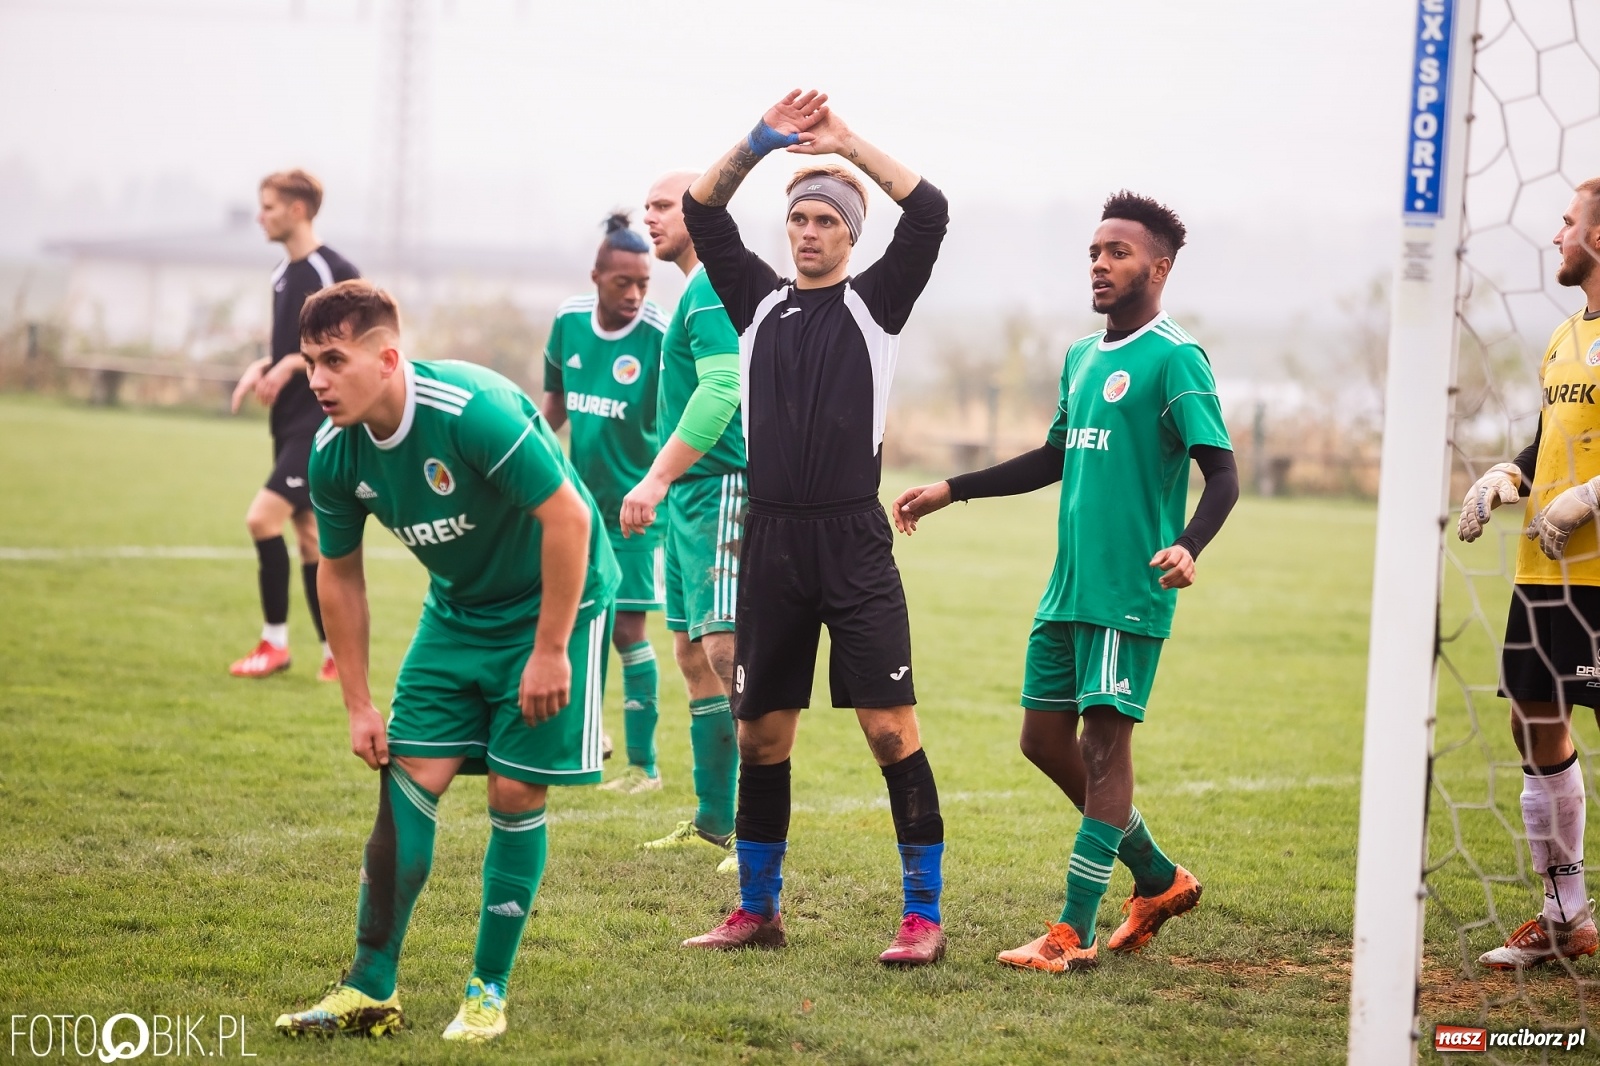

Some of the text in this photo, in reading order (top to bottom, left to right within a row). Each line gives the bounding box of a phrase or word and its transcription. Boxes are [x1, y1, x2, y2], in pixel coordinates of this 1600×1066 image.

[566, 391, 628, 420] BUREK
[1065, 427, 1112, 451] UREK
[392, 513, 476, 547] UREK
[735, 664, 746, 694] 9
